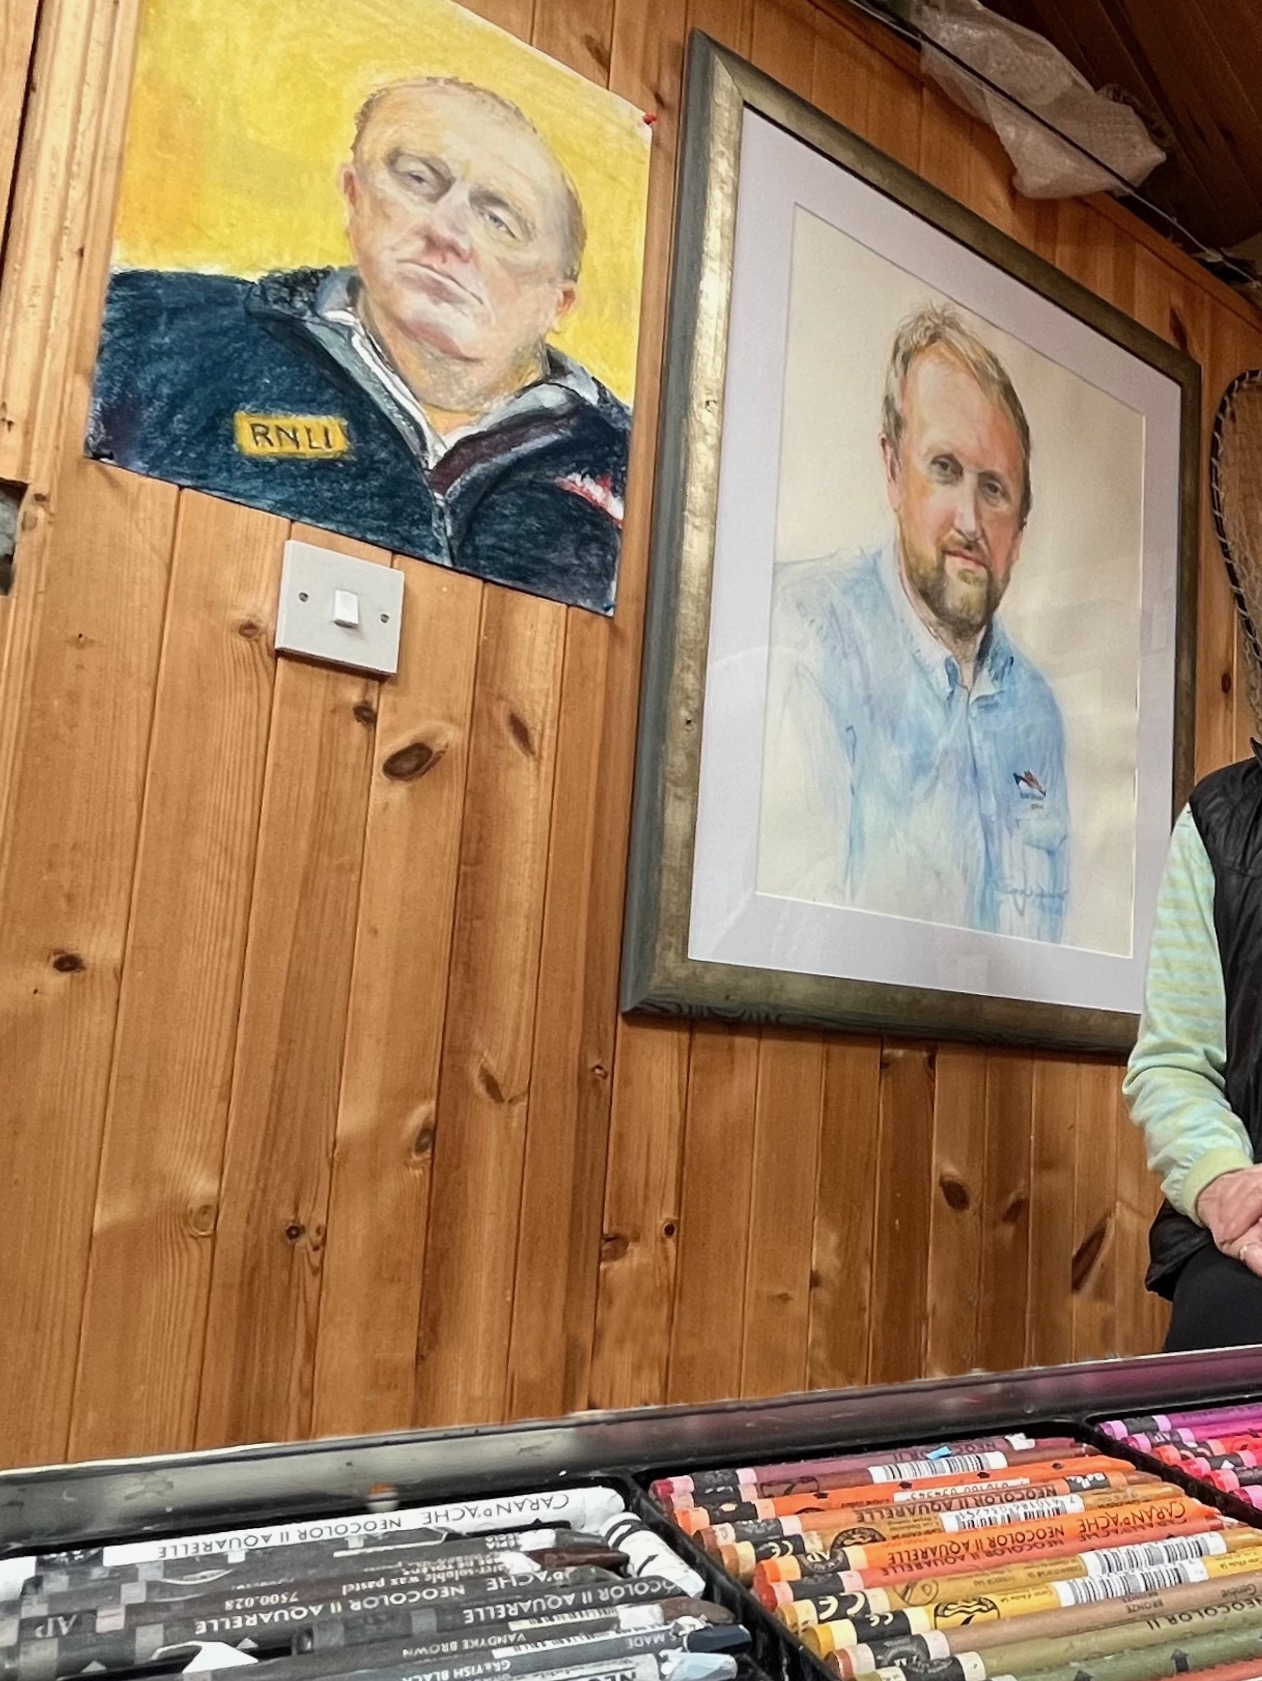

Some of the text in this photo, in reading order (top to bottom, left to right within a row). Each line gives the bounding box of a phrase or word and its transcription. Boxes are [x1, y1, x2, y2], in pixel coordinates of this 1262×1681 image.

[251, 422, 334, 451] RNLI
[960, 1495, 969, 1508] II
[973, 1485, 1057, 1507] NEOCOLOR
[855, 1498, 954, 1523] AQUARELLE
[280, 1531, 289, 1545] II
[297, 1517, 402, 1541] NEOCOLOR
[987, 1525, 1065, 1550] NEOCOLOR
[157, 1533, 273, 1559] AQUARELLE
[886, 1538, 970, 1564] AQUARELLE
[975, 1537, 984, 1551] II
[424, 1563, 504, 1585] ater-soluble
[225, 1591, 299, 1610] 7500.028
[331, 1601, 341, 1614] II
[349, 1584, 466, 1611] NEOCOLOR
[463, 1578, 681, 1623] OCOLOR II AQUARELLE
[194, 1604, 324, 1634] AQUARELLE
[1147, 1614, 1162, 1630] II
[403, 1633, 526, 1657] VANDYKE BROWN
[625, 1633, 666, 1648] MADE
